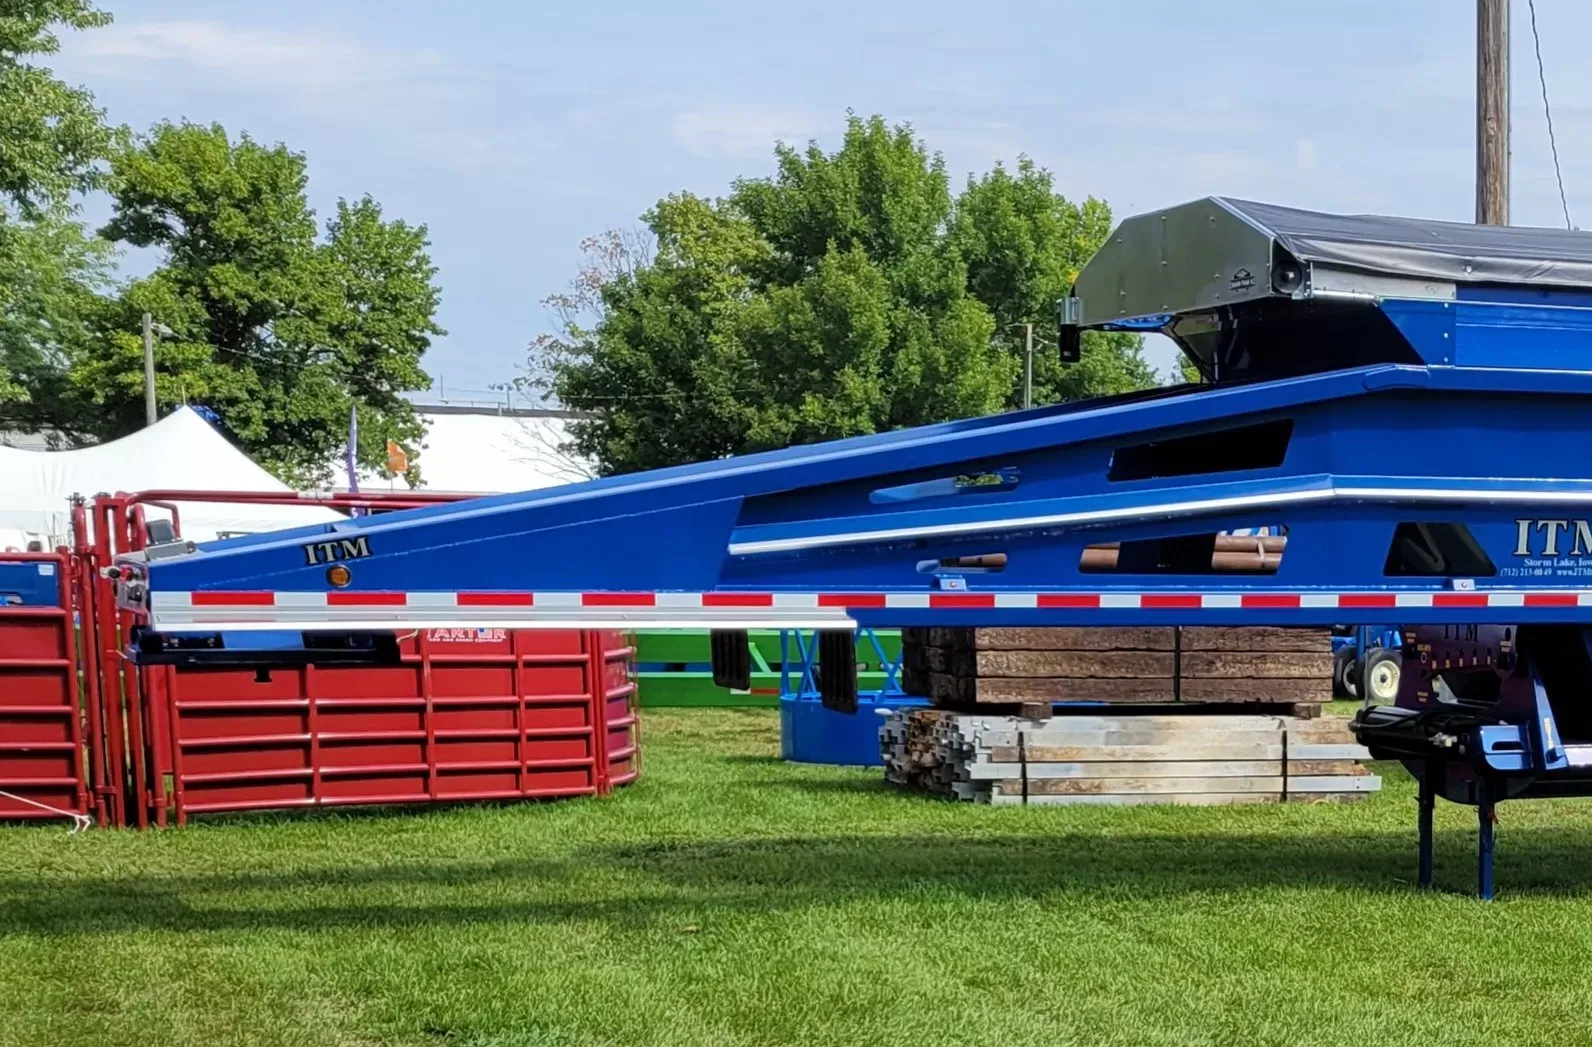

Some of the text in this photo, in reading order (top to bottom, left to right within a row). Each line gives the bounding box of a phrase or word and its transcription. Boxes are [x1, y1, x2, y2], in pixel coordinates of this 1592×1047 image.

[305, 535, 371, 566] ITM
[1523, 558, 1552, 567] Storm
[1553, 558, 1577, 567] Lake,
